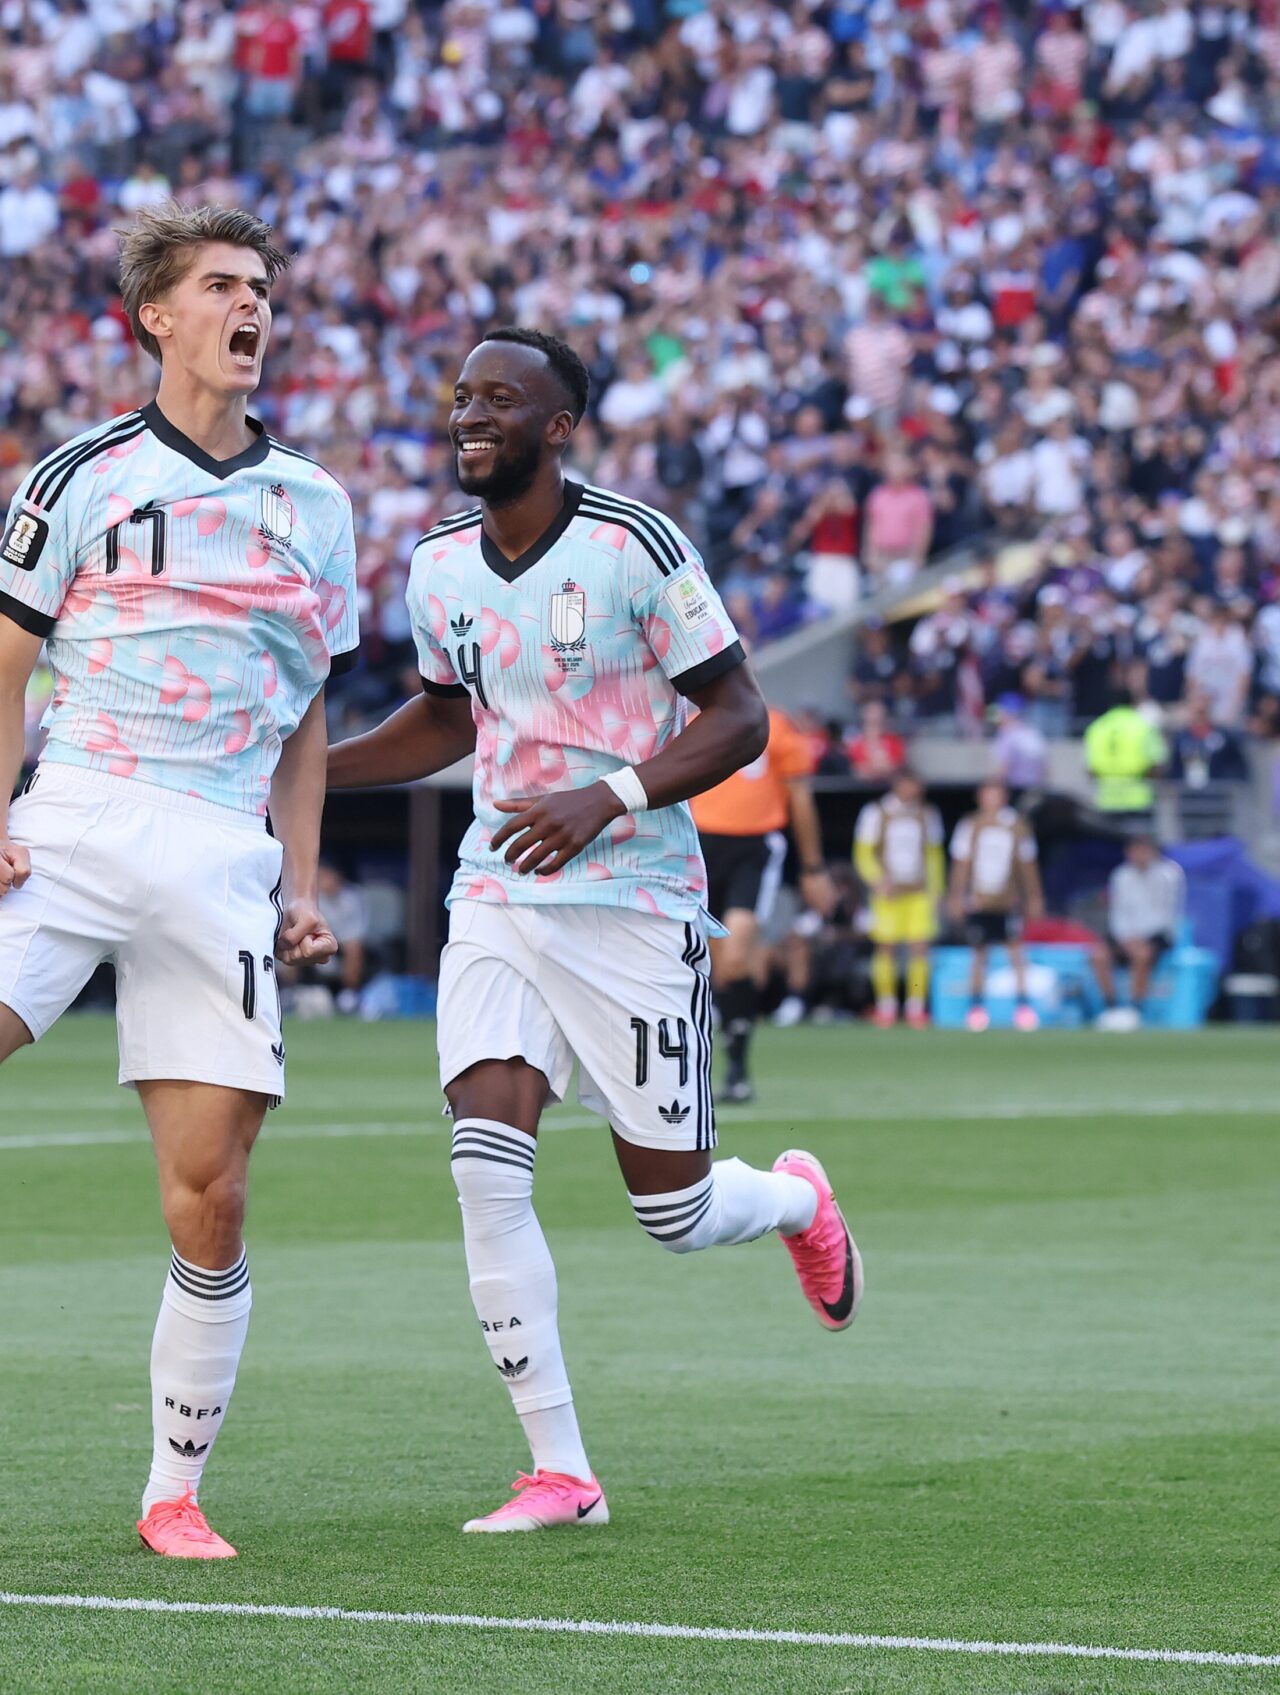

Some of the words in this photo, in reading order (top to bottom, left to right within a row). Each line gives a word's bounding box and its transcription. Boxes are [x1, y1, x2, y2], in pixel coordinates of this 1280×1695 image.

[2, 549, 25, 565] 2026
[106, 508, 168, 578] 17
[630, 1017, 689, 1089] 14
[165, 1396, 222, 1421] RBFA
